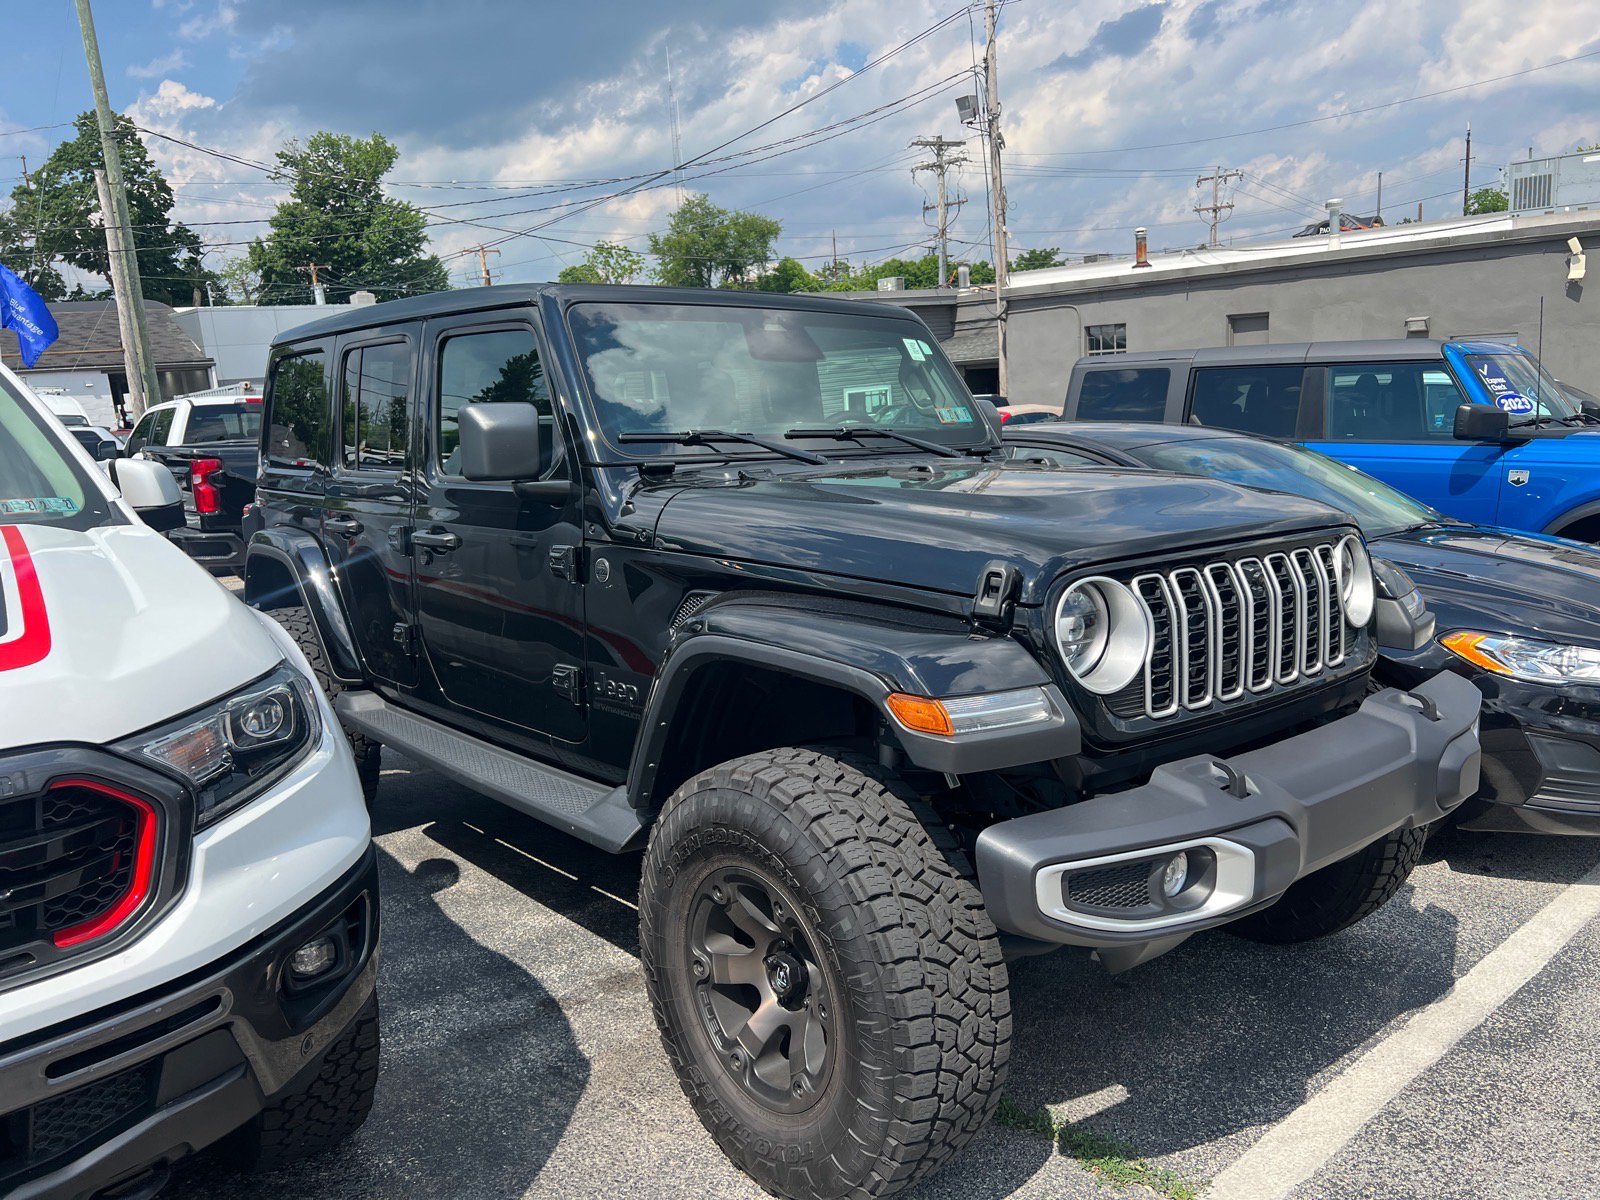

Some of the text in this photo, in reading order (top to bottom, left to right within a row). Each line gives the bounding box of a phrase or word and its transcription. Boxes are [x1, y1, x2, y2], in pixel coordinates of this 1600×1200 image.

[9, 298, 26, 313] Blue
[11, 308, 44, 336] vantage
[1501, 398, 1531, 411] 2023
[593, 671, 640, 704] Jeep
[699, 990, 724, 1048] FUEL
[753, 1138, 814, 1164] TOYO
